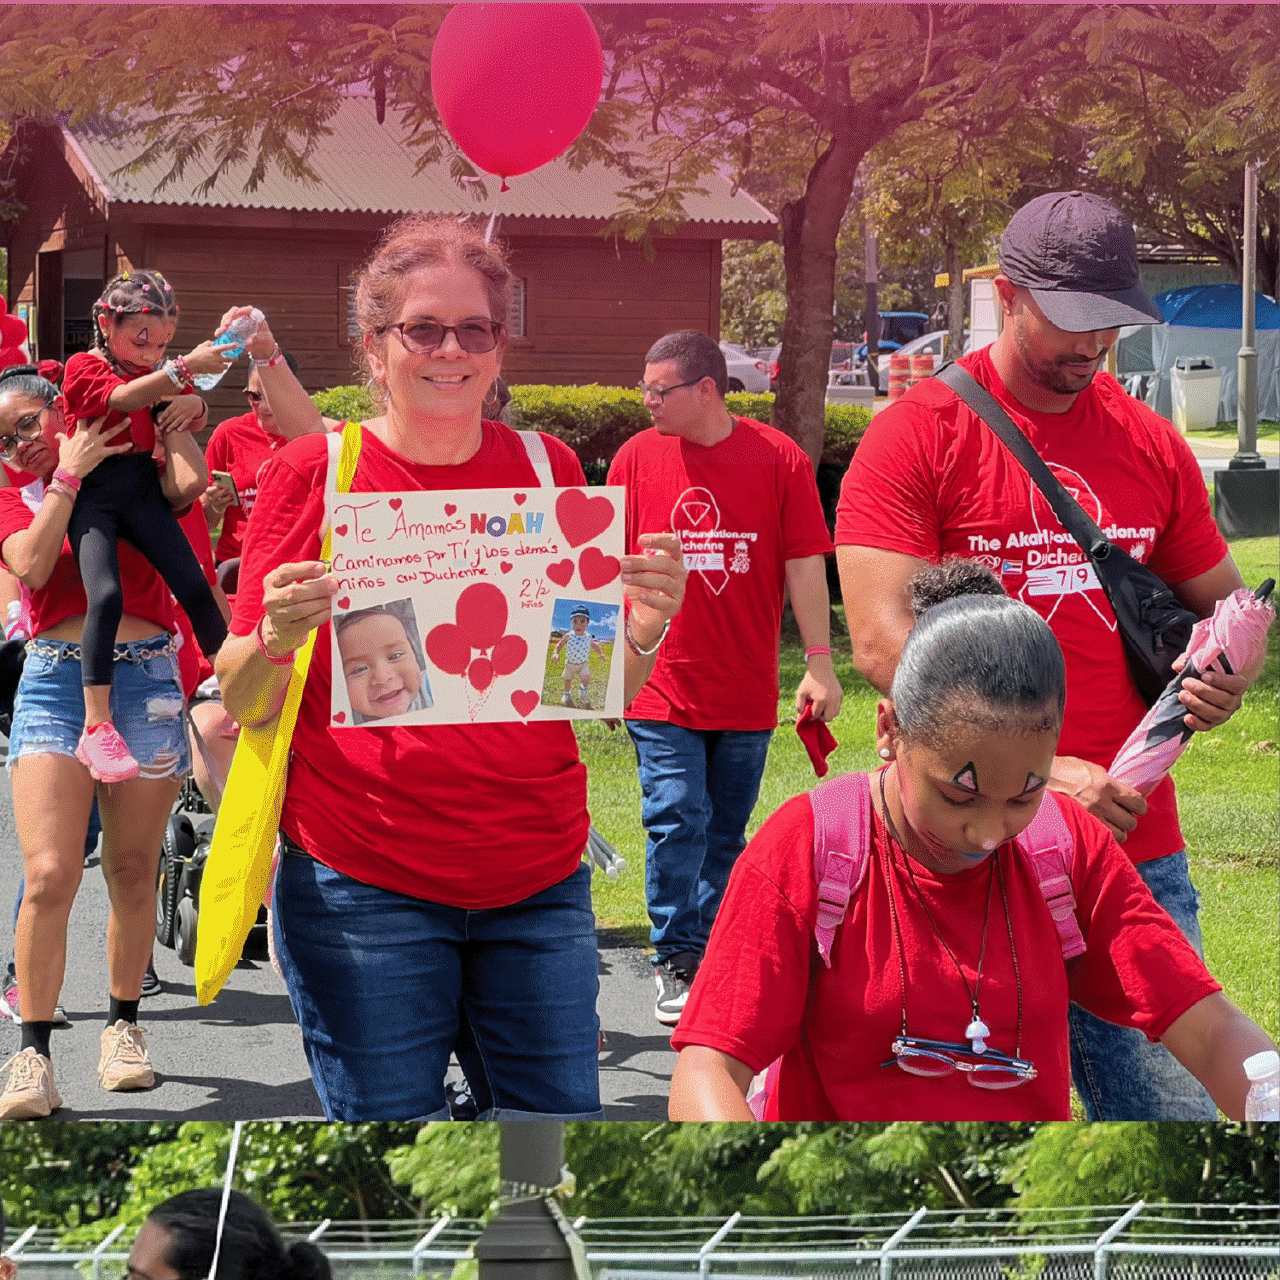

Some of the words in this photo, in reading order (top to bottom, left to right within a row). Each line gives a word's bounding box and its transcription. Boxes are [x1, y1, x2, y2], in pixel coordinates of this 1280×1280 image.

[334, 500, 380, 543] Te
[470, 512, 545, 537] NOAH
[682, 529, 758, 542] Foundation.org
[968, 535, 1002, 551] The
[332, 553, 422, 572] Caminamos
[337, 577, 386, 590] niños
